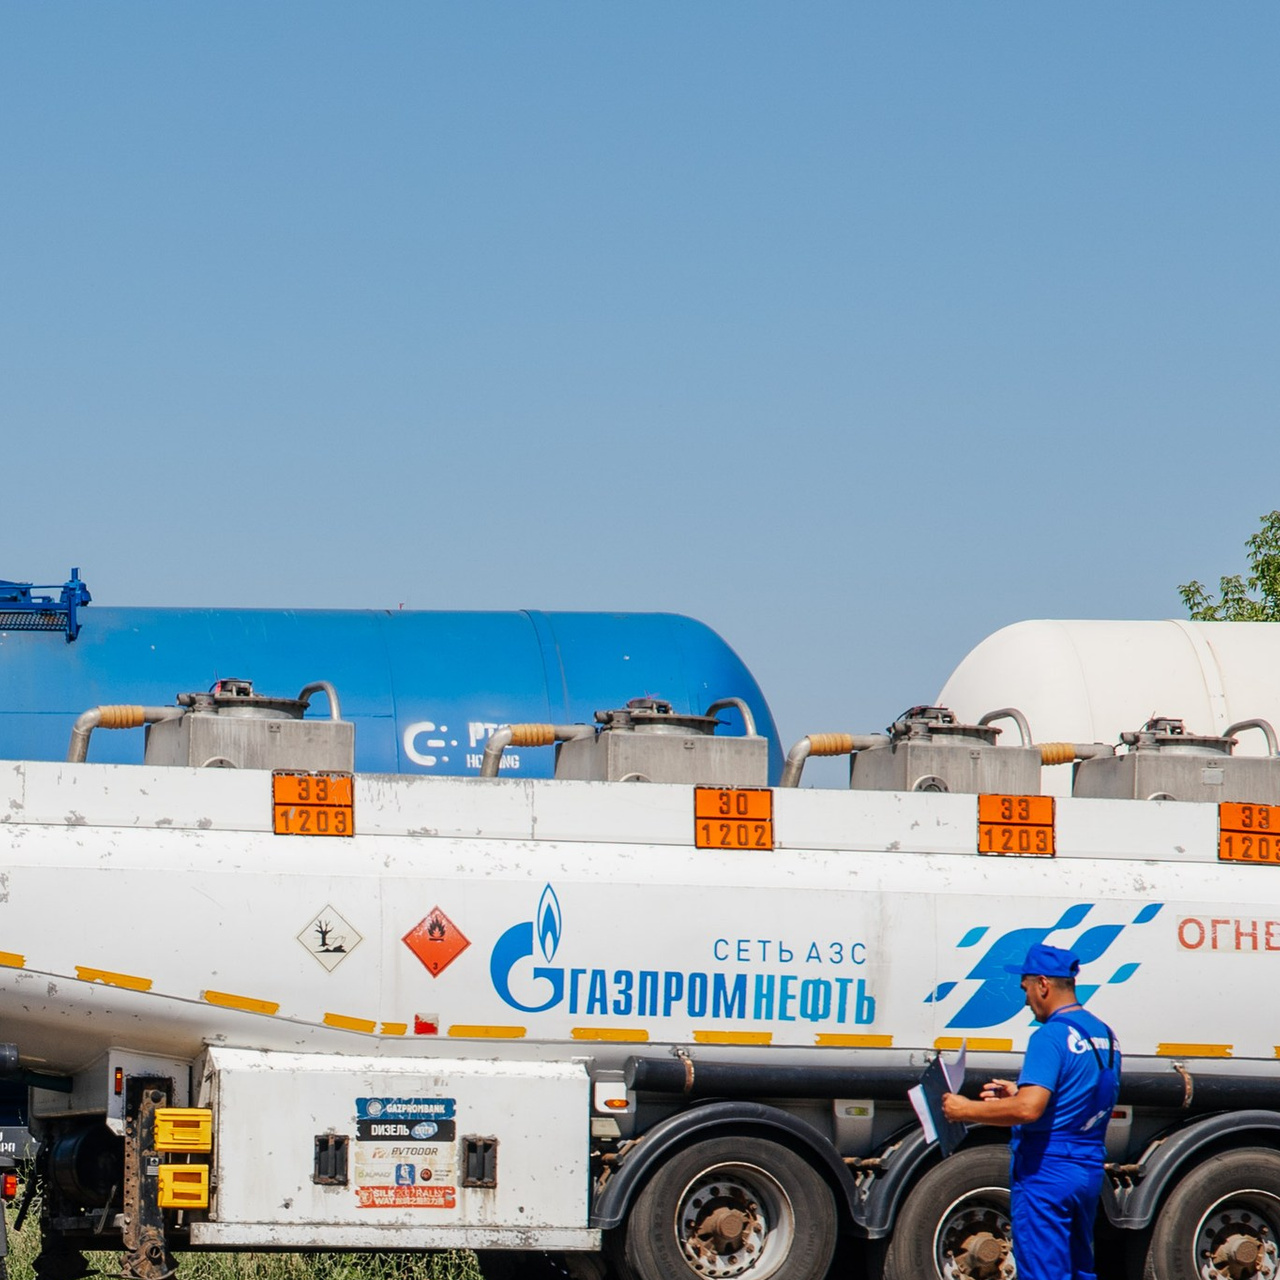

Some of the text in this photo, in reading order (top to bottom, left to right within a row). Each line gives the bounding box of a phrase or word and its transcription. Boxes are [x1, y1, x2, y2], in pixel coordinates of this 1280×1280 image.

[468, 722, 513, 748] PT
[298, 778, 328, 801] 33
[719, 792, 748, 815] 30
[1001, 798, 1030, 820] 33
[281, 809, 346, 833] 1203
[1242, 806, 1270, 829] 33
[702, 823, 766, 847] 1202
[984, 828, 1048, 851] 1203
[713, 938, 866, 965] СЕТЬ АЗС
[432, 962, 439, 970] 3
[568, 967, 876, 1025] ГАЗПРОМНЕФТЬ
[386, 1104, 445, 1114] GAZPROMBANK
[391, 1147, 438, 1156] AVTODOR
[373, 1189, 395, 1198] SILK
[375, 1197, 394, 1205] WAY
